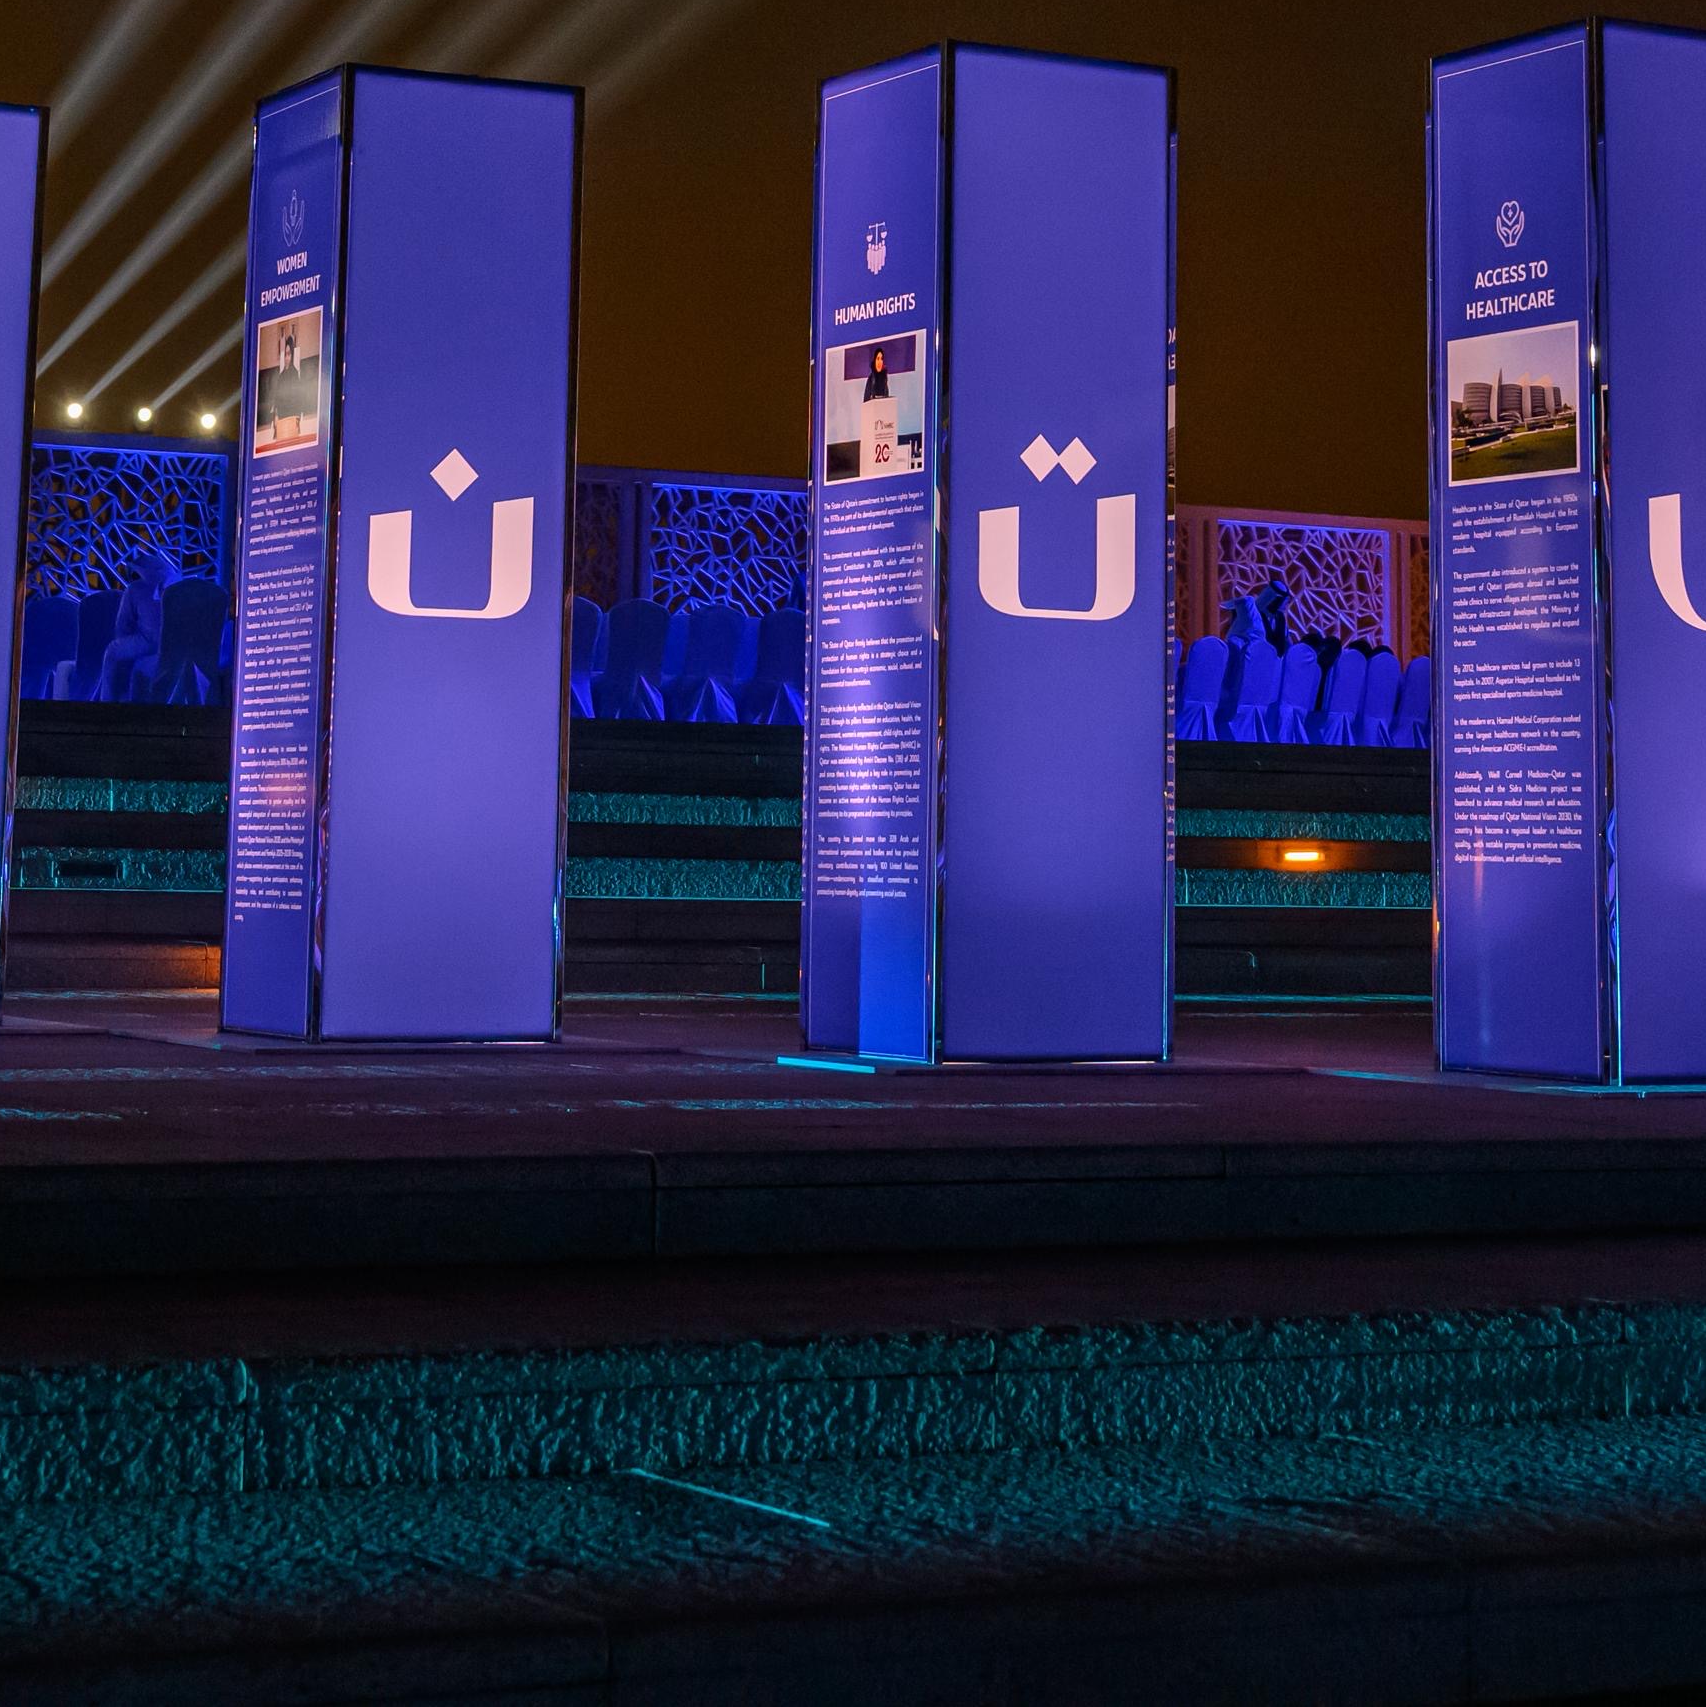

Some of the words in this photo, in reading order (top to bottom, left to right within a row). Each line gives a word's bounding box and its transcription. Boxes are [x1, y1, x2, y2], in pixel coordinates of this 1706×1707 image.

[277, 252, 307, 275] WOMEN
[1475, 264, 1526, 289] ACCESS
[1528, 260, 1549, 280] TO
[261, 275, 320, 307] EMPOWERMENT
[1467, 289, 1555, 320] HEALTHCARE
[835, 302, 874, 325] HUMAN
[876, 293, 915, 316] RIGHTS
[368, 449, 534, 619] ن
[979, 434, 1135, 620] ت
